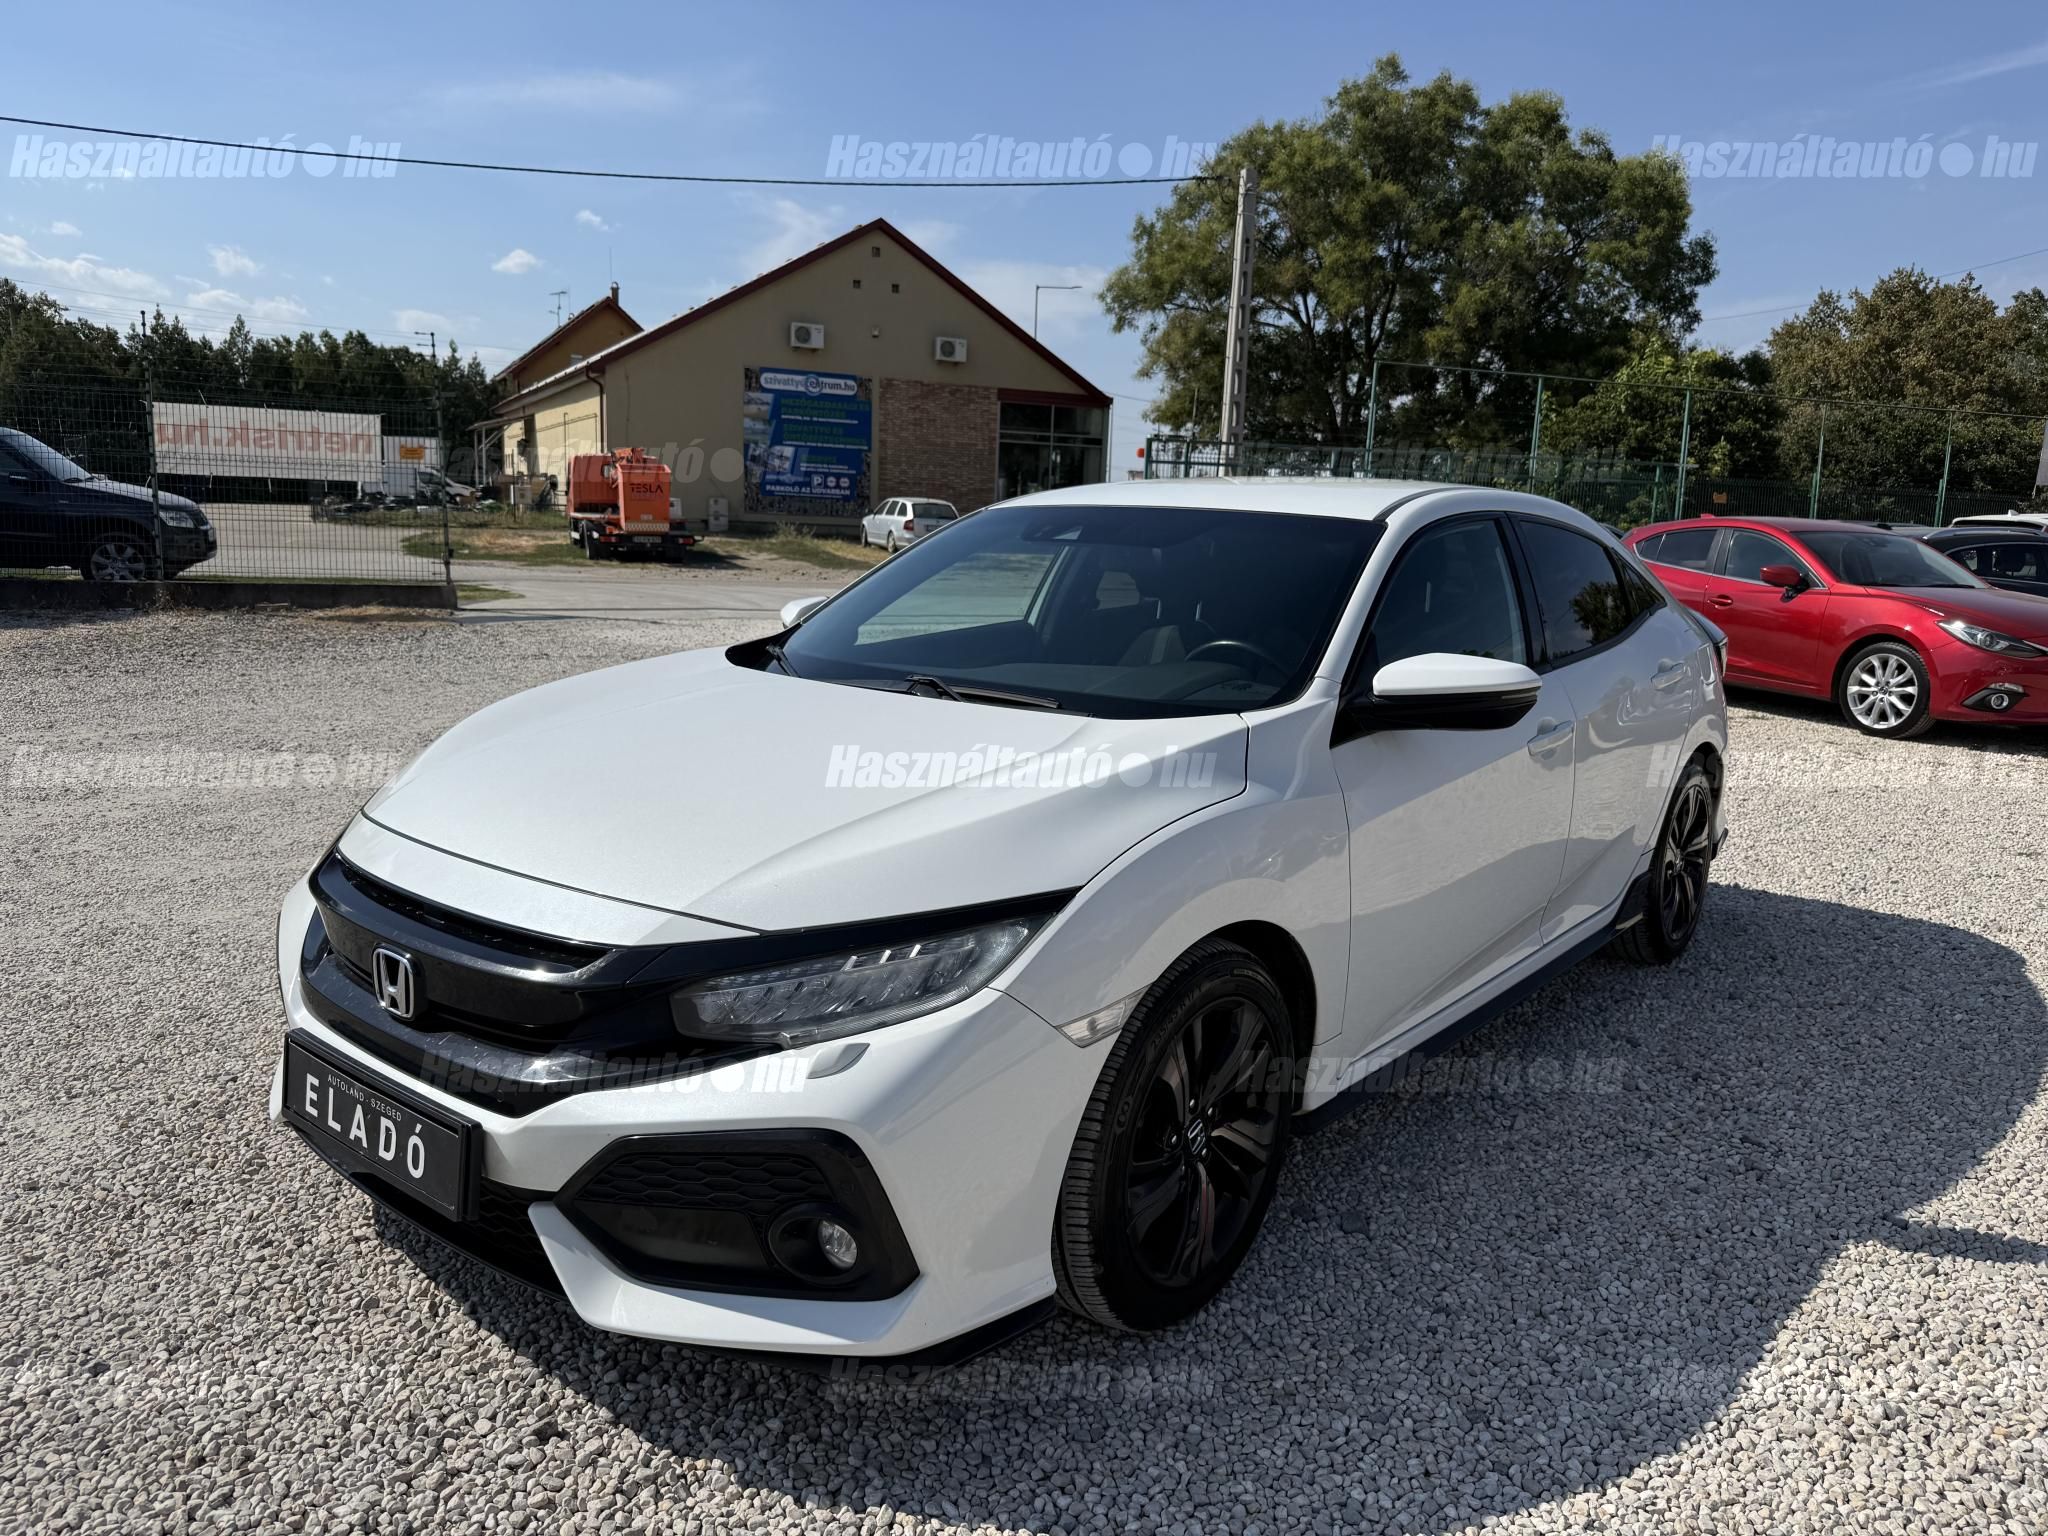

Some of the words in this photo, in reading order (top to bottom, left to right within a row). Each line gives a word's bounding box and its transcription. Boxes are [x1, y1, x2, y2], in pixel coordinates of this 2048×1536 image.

[629, 482, 663, 494] TESLA
[765, 484, 800, 494] PARKOLÓ
[327, 1074, 365, 1102] AUTOLAND
[370, 1099, 402, 1121] SZEGED
[305, 1073, 425, 1179] ELADÓ
